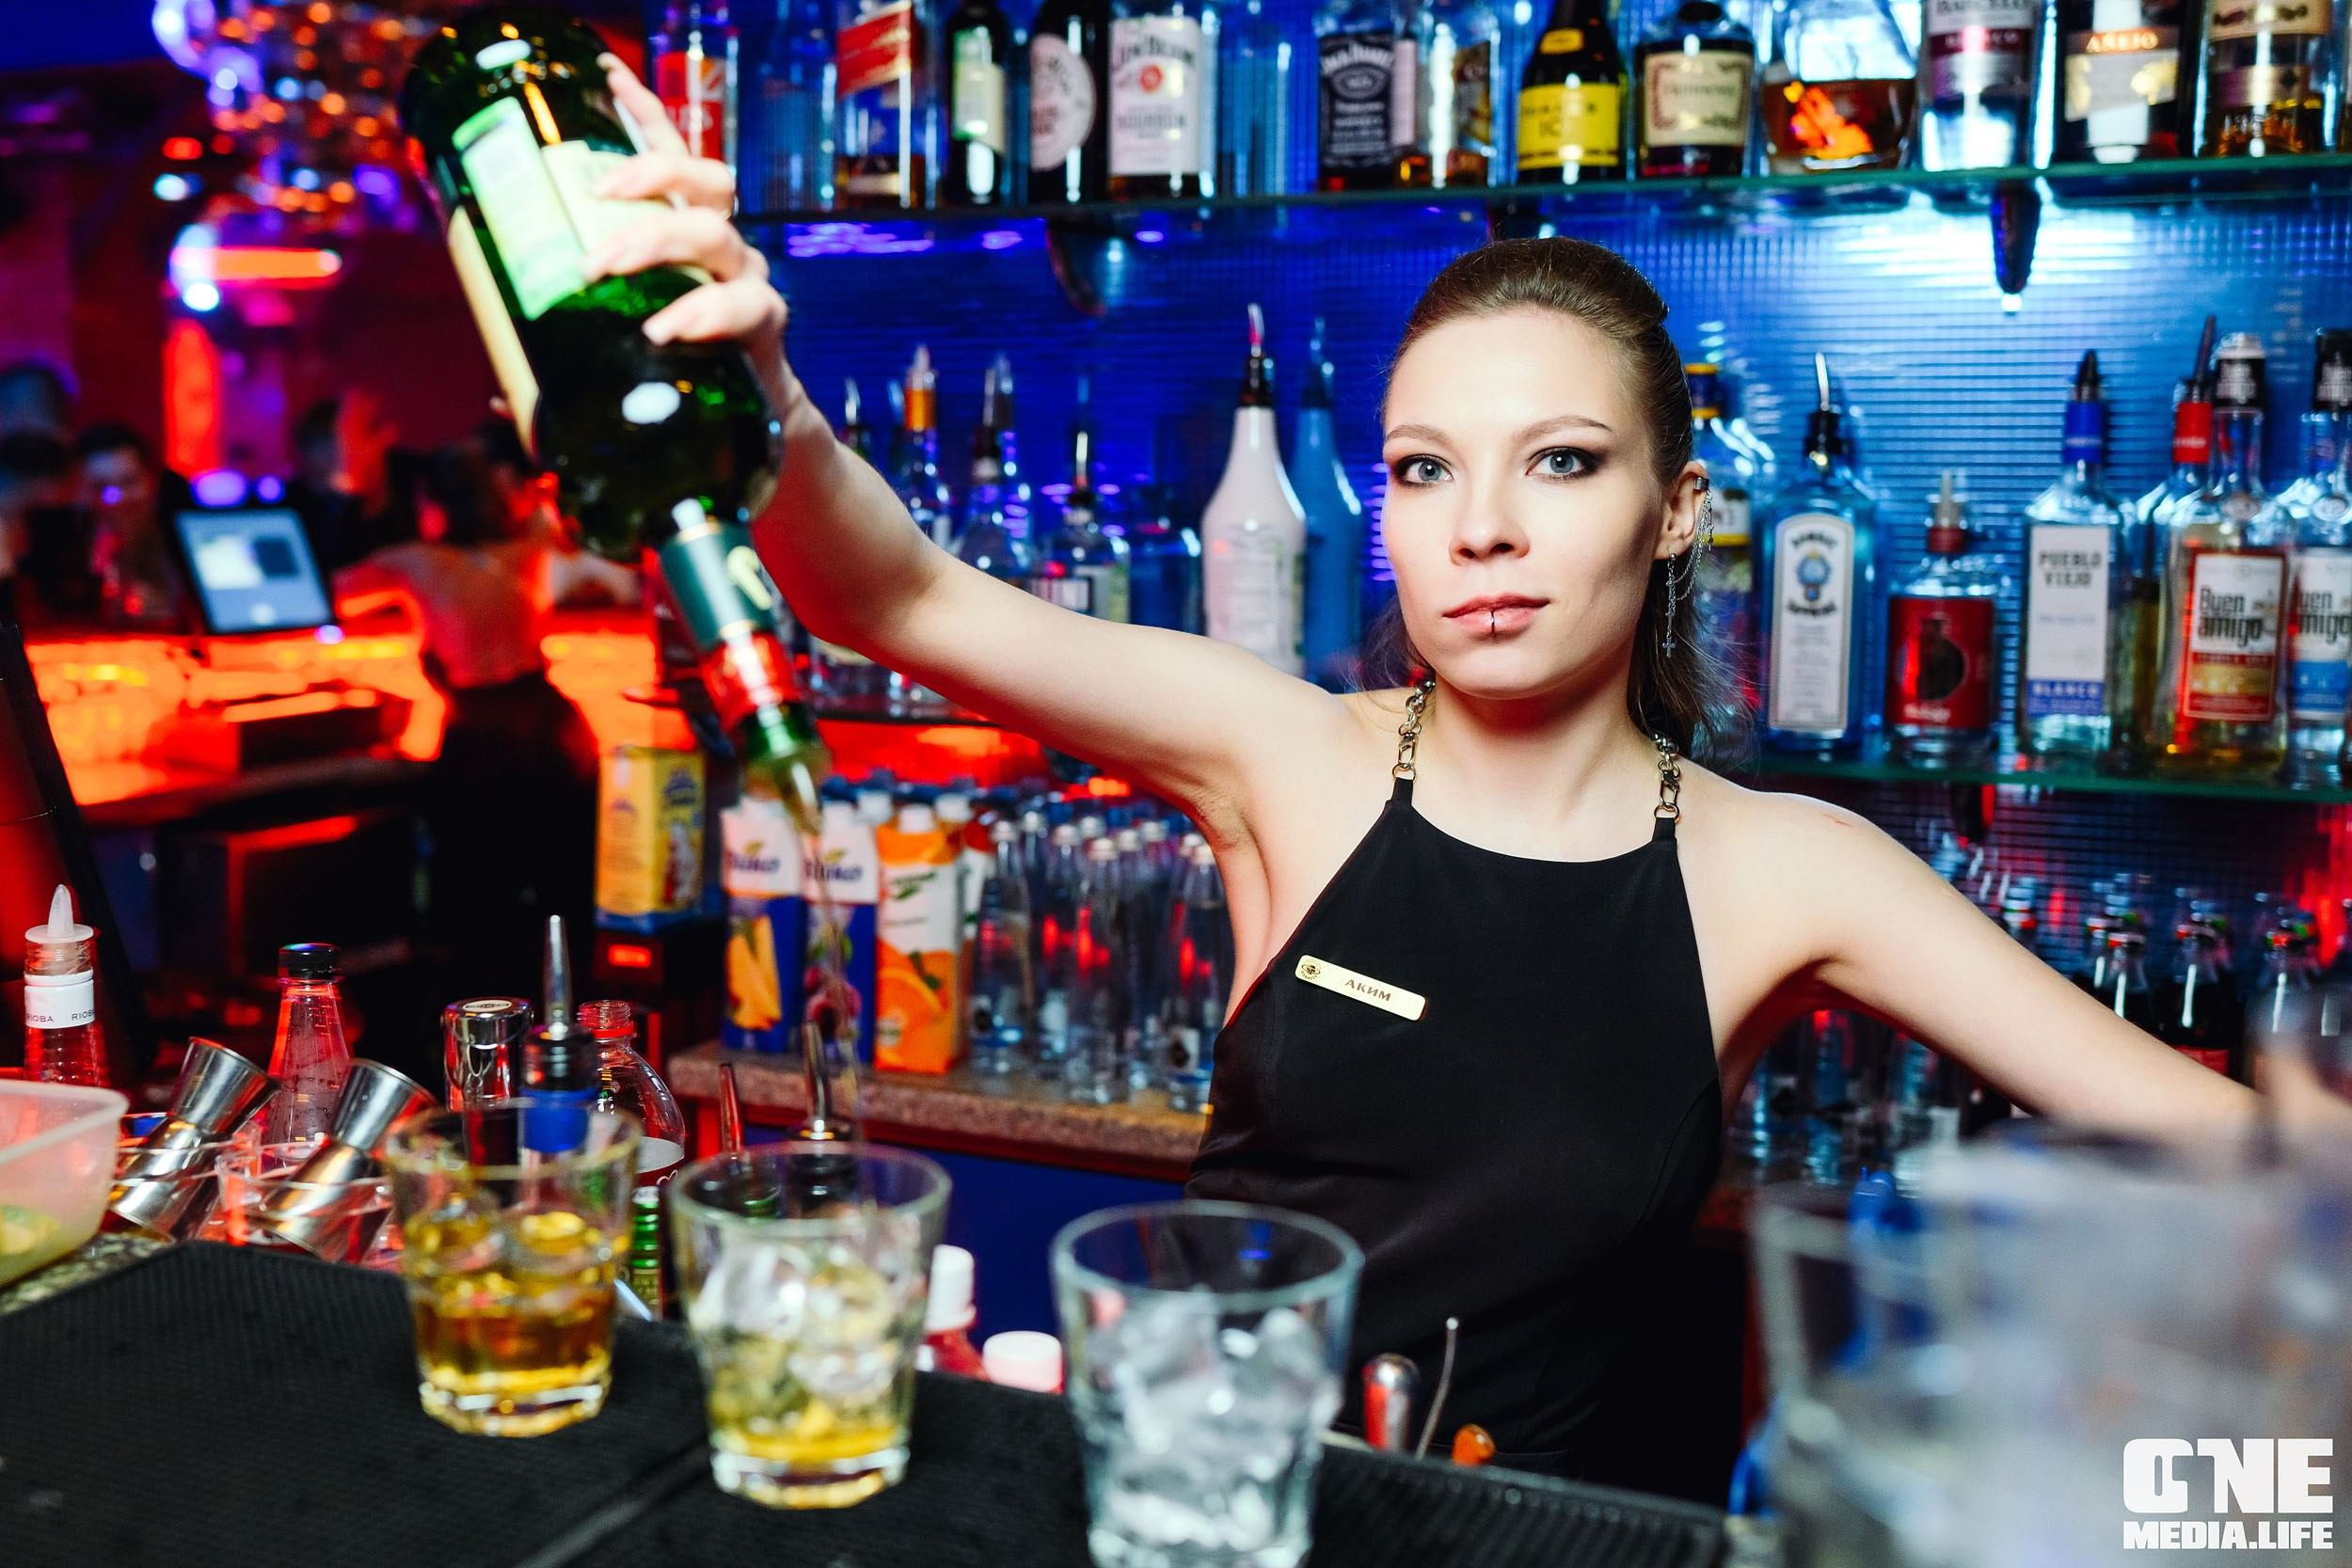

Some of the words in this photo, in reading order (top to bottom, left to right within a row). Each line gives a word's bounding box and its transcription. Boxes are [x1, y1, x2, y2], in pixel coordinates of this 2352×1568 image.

[2039, 551, 2103, 568] PUEBLO
[2044, 571, 2092, 588] VIEJO
[2200, 586, 2245, 616] Buen
[2198, 616, 2265, 648] amigo
[2299, 612, 2351, 646] migo
[1345, 979, 1391, 1002] АКИМ
